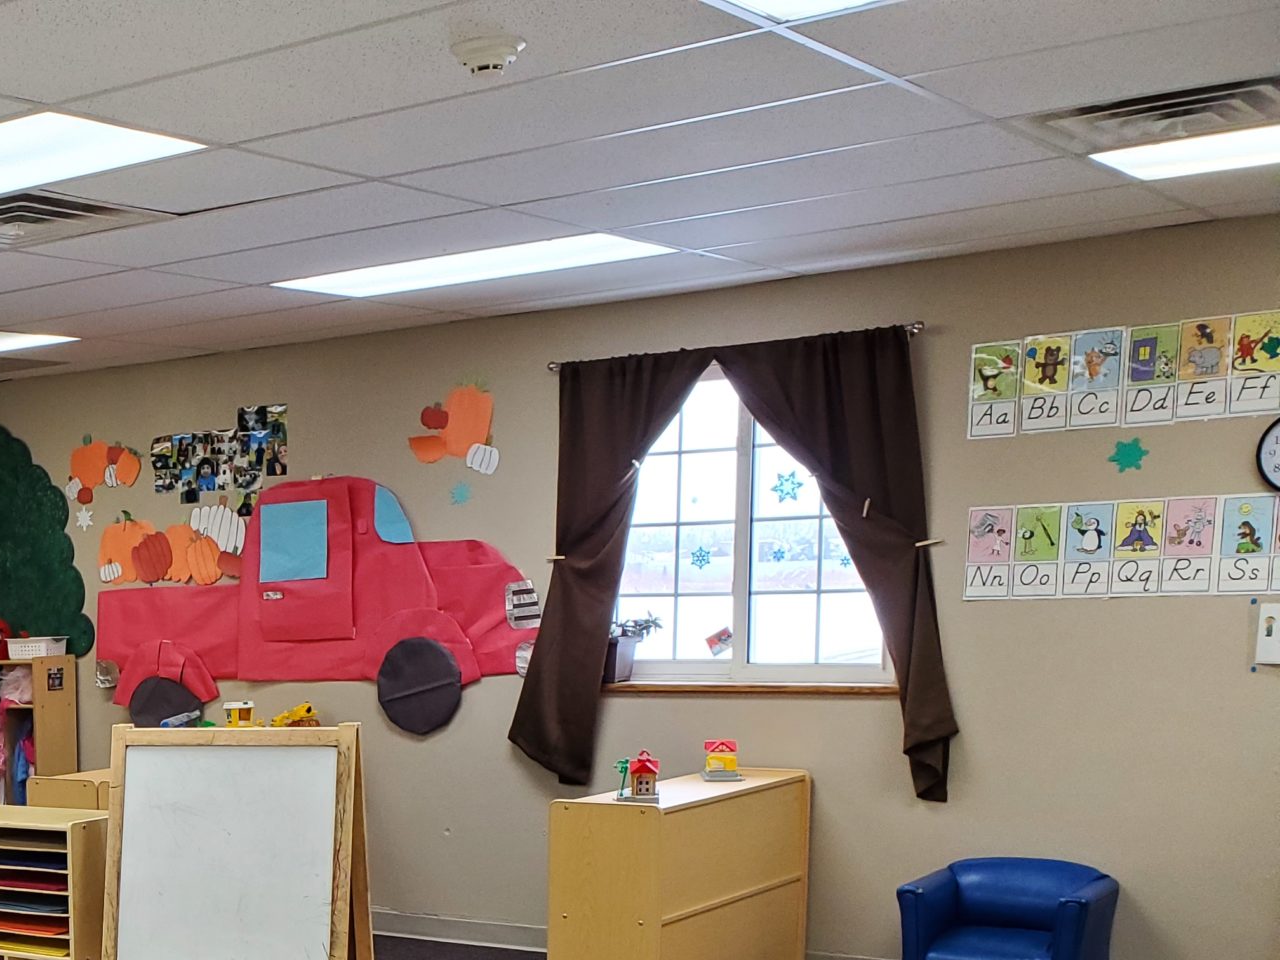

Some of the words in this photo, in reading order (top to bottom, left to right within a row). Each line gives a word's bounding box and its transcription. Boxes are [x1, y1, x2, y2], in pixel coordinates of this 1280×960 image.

[975, 403, 1010, 425] Aa
[1027, 396, 1059, 420] Bb
[1077, 392, 1110, 415] Cc
[1130, 388, 1168, 412] Dd
[1184, 381, 1217, 406] Ee
[1236, 375, 1277, 401] Ff
[969, 566, 1005, 587] Nn
[1019, 564, 1050, 586] Oo
[1071, 562, 1102, 593] Pp
[1117, 560, 1153, 592] Qq
[1168, 558, 1205, 581] Rr
[1227, 558, 1260, 581] Ss
